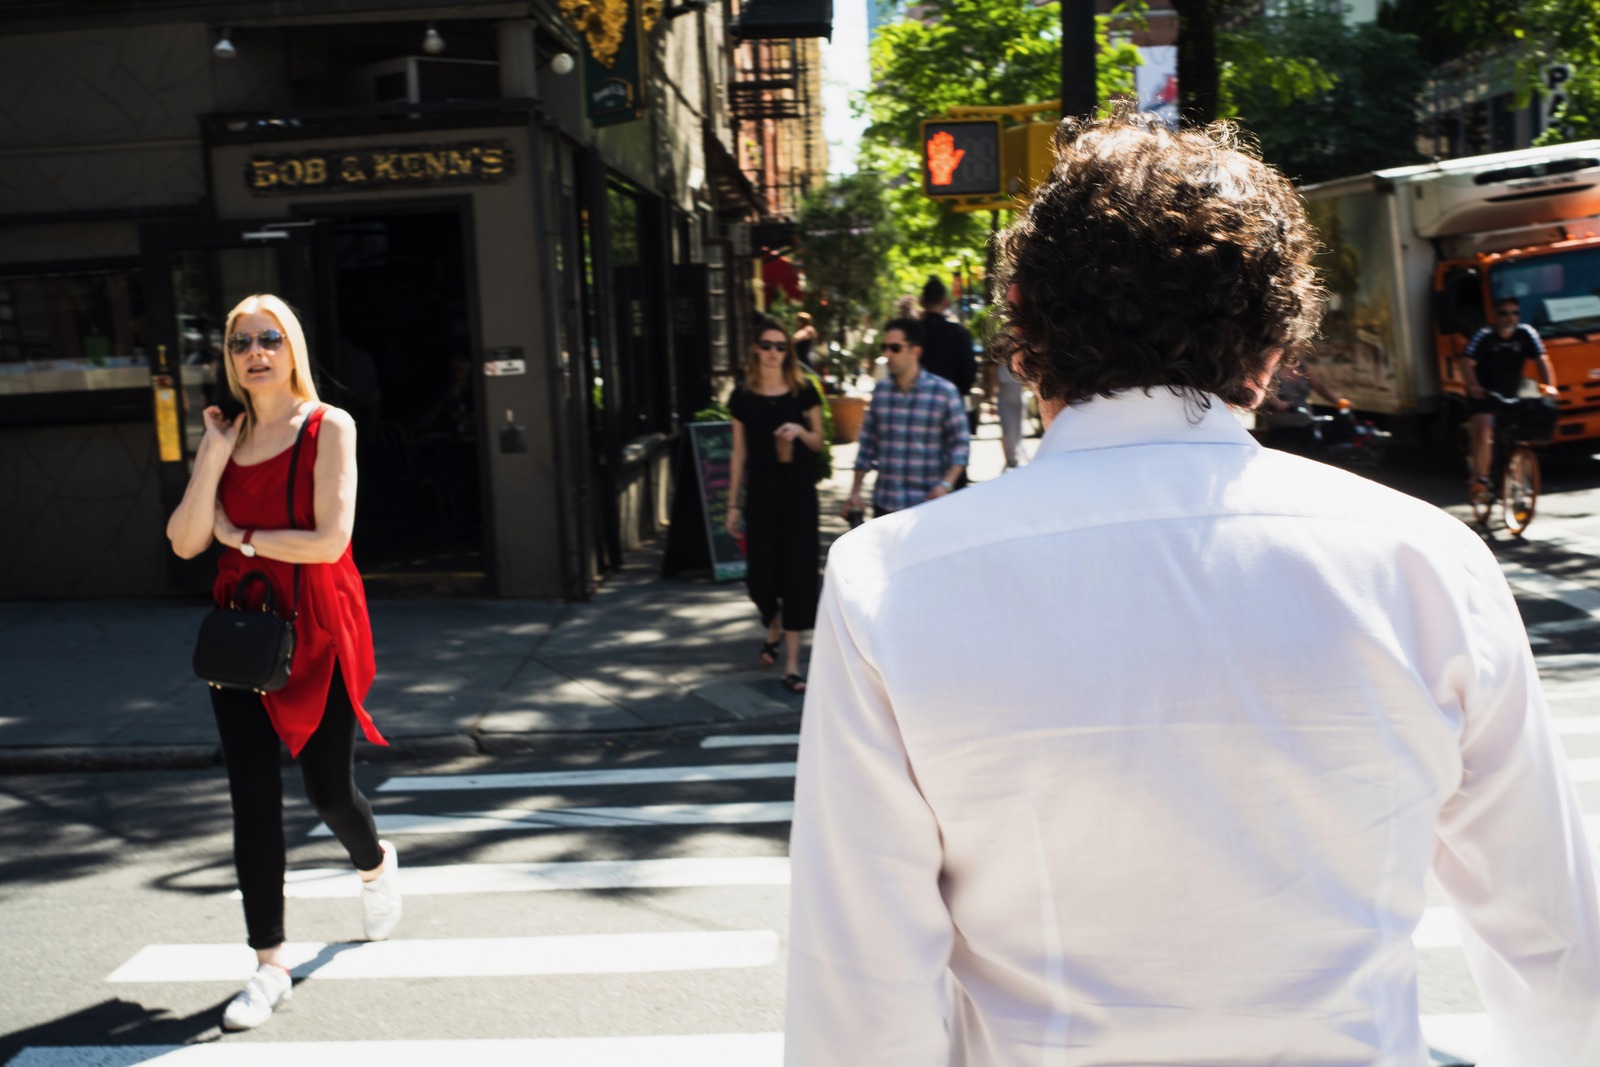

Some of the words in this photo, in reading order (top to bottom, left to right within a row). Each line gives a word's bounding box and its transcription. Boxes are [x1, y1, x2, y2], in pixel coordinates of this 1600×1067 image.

[251, 157, 328, 188] BOB
[341, 155, 367, 182] &
[371, 146, 504, 180] KENN'S
